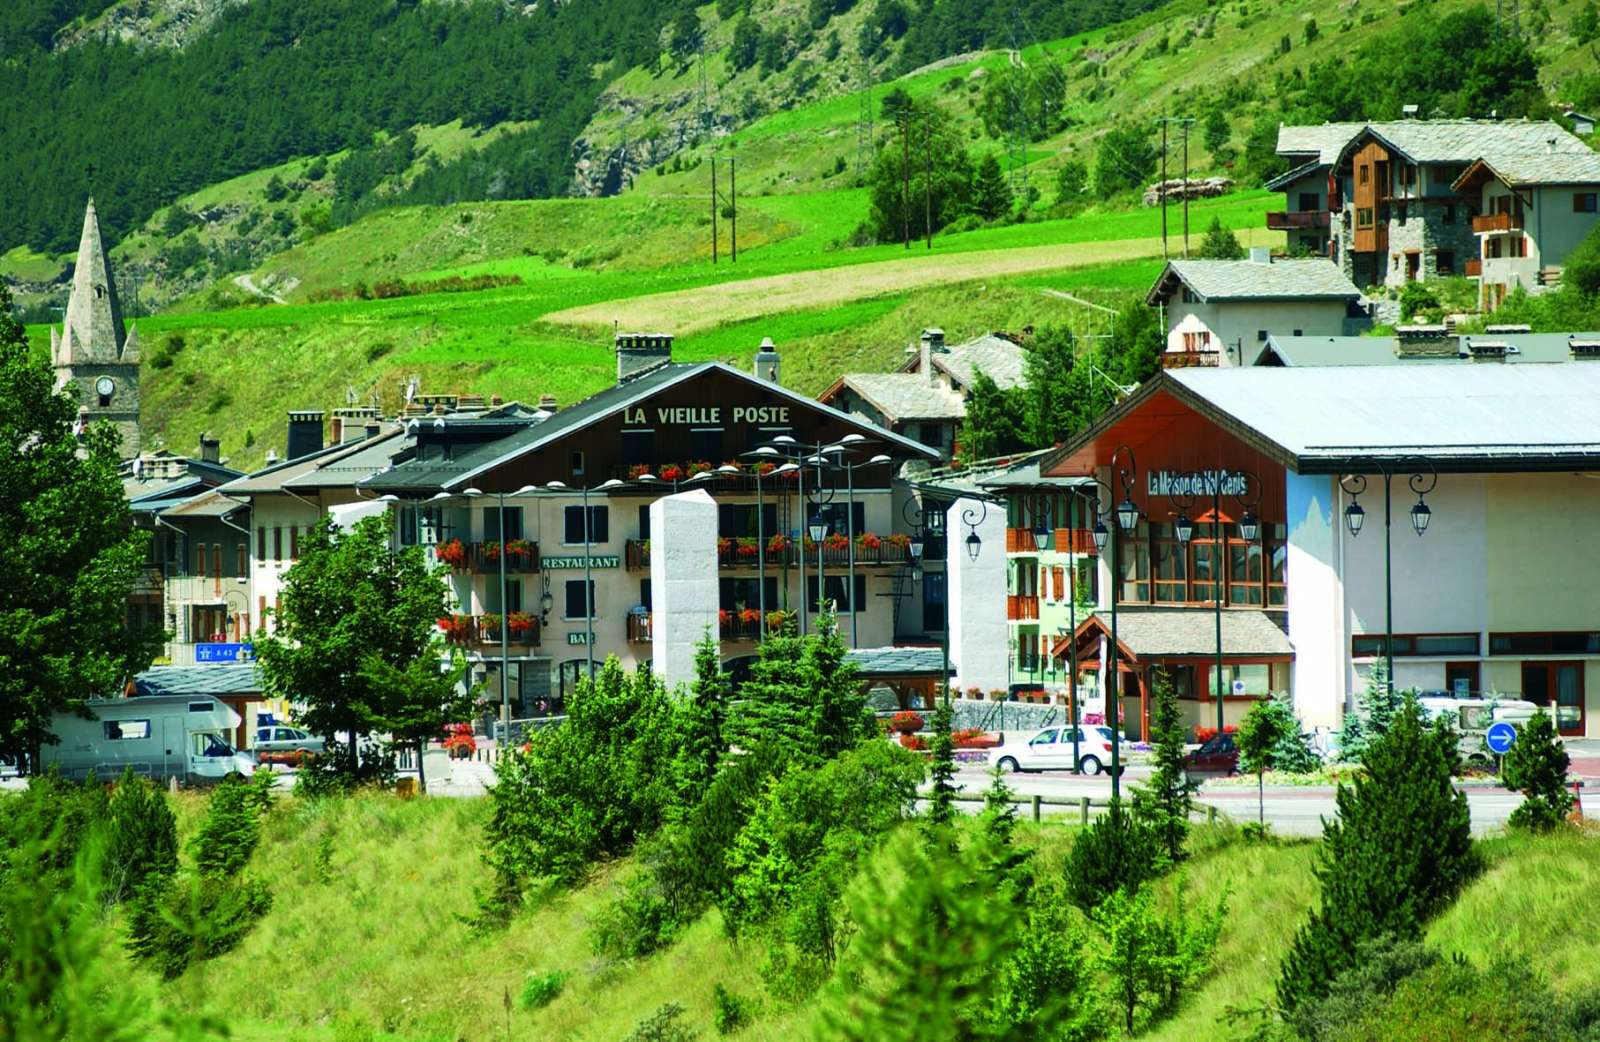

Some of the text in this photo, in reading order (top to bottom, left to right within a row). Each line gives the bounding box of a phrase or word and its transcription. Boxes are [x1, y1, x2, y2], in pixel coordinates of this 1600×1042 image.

[624, 407, 790, 424] LA VIEILLE POSTE
[1147, 471, 1158, 495] La
[1159, 471, 1190, 496] Maison
[1191, 472, 1203, 496] de
[1220, 469, 1246, 496] Cenis
[543, 557, 619, 569] RESTAURANT
